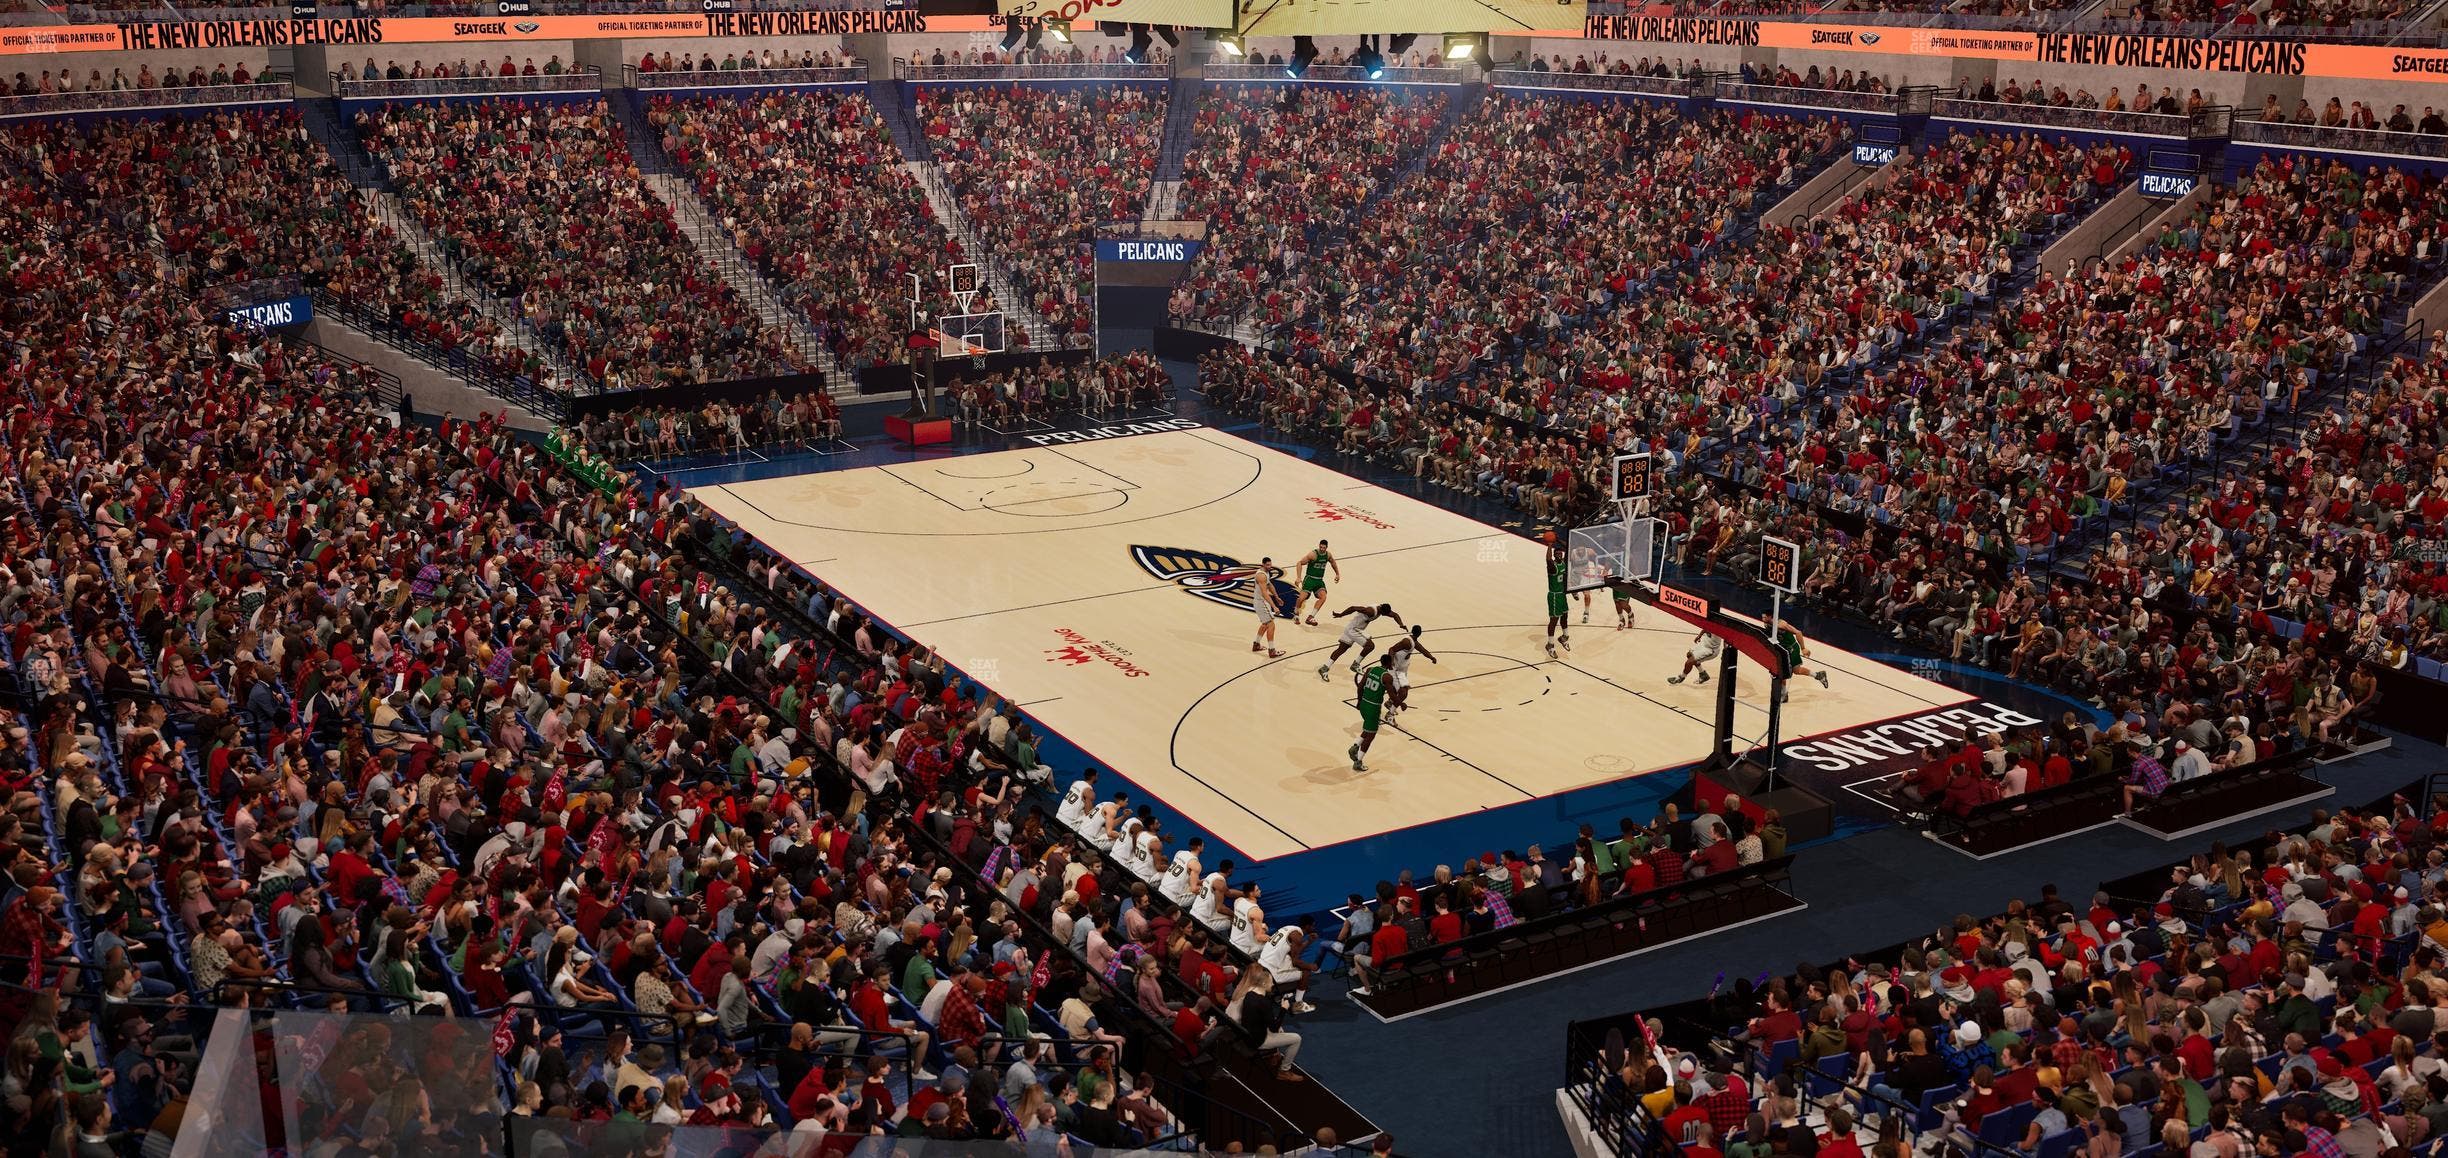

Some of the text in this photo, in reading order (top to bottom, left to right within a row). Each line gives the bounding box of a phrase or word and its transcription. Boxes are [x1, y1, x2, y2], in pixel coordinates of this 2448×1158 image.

[3, 19, 382, 50] OFFICIAL TICKETING PARTNER OF THE NEW ORLEANS PELICANS
[454, 22, 507, 35] SEATGEEK
[598, 10, 926, 36] OFFICIAL TICKETING PARTNER OF THE NEW ORLEANS PELICANS
[1584, 16, 1760, 46] THE NEW ORLEANS PELICANS
[1812, 30, 1854, 46] SEATGEEK
[1931, 34, 2306, 76] OFFICIAL TICKETING PARTNER OF THE NEW ORLEANS PELICANS
[2143, 175, 2192, 196] PELICANS
[1118, 242, 1184, 260] PELICANS
[1024, 418, 1202, 446] PELICANS
[1624, 474, 1642, 494] 88
[1768, 560, 1786, 584] 88
[1664, 590, 1702, 614] SEATGEEK
[1054, 628, 1150, 678] SMOOTHIE KING
